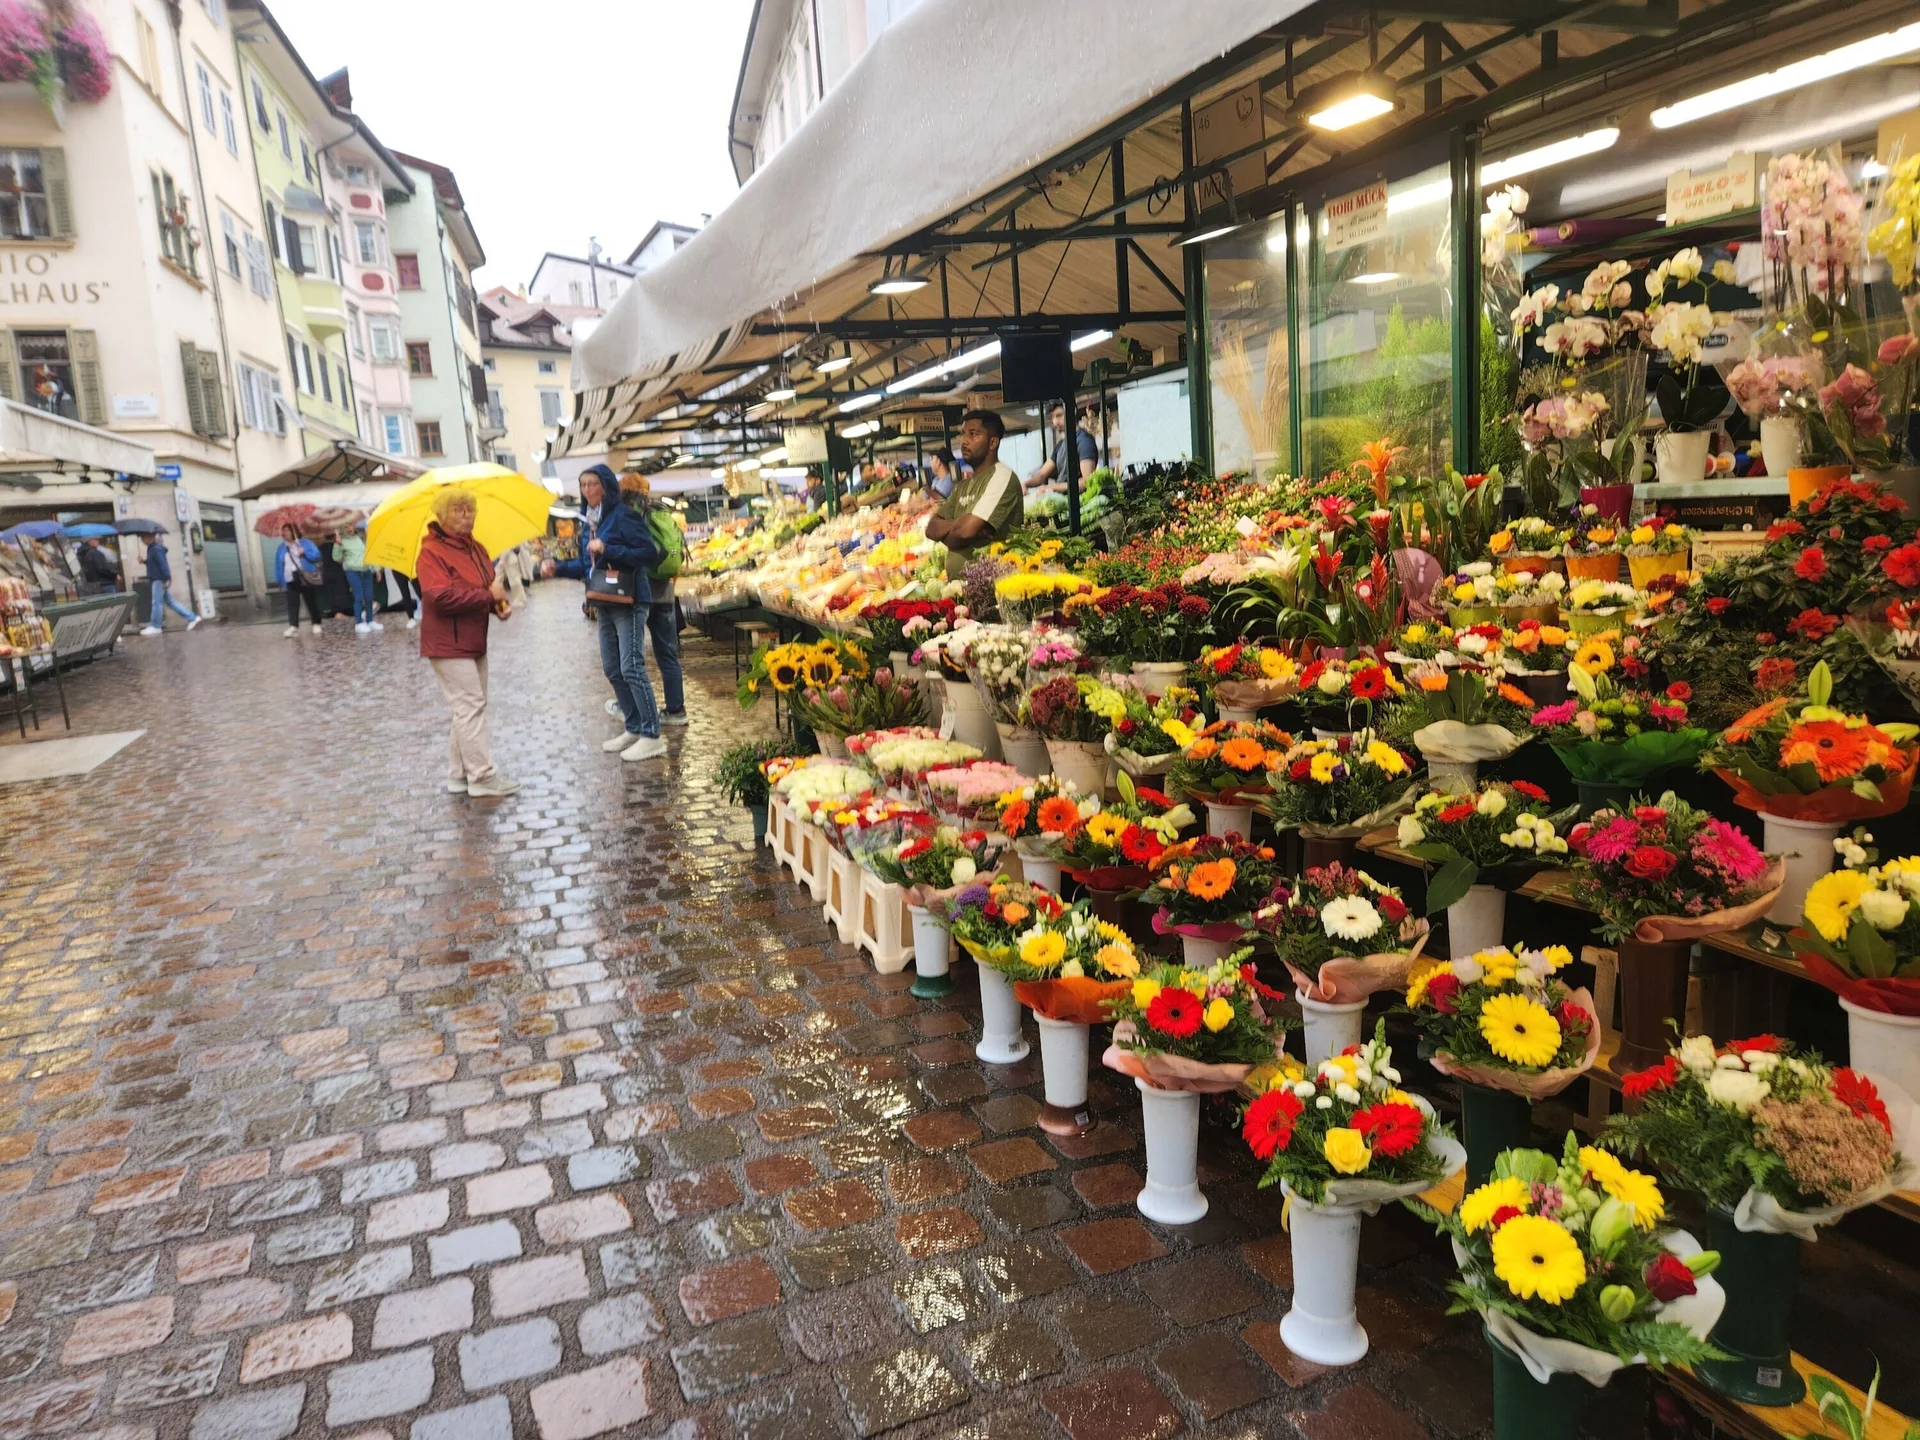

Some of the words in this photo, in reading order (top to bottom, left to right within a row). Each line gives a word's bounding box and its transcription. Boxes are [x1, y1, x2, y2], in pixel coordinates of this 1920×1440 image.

[1199, 115, 1210, 132] 46
[1356, 186, 1386, 209] MÜCK
[0, 252, 58, 275] IO"
[788, 427, 797, 438] 44
